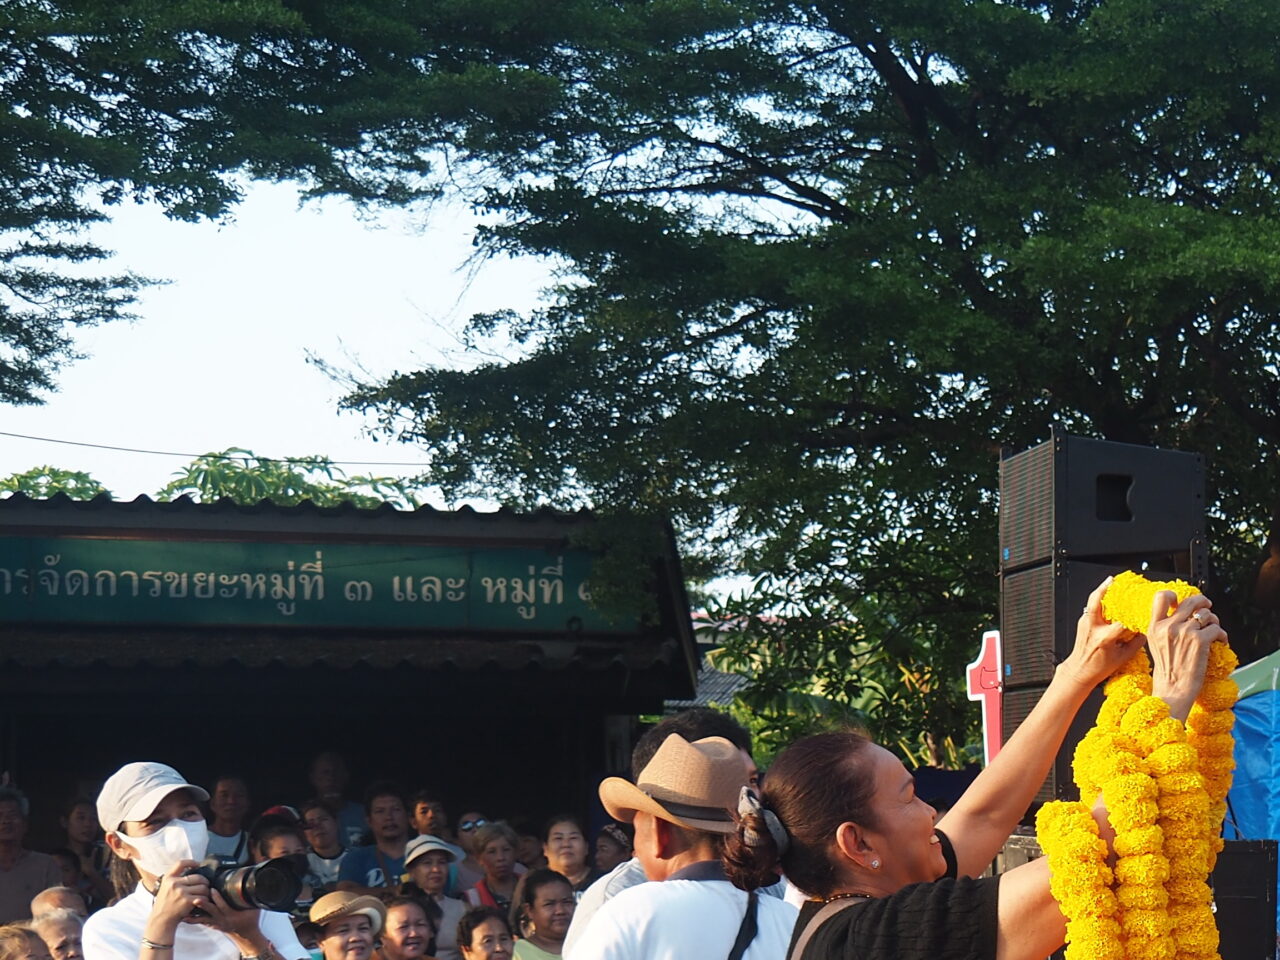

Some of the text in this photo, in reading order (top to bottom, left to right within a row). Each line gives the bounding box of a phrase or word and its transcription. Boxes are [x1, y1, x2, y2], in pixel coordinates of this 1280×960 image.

[345, 579, 373, 602] ๓
[393, 574, 466, 602] และ
[481, 555, 564, 620] หมู่ที่
